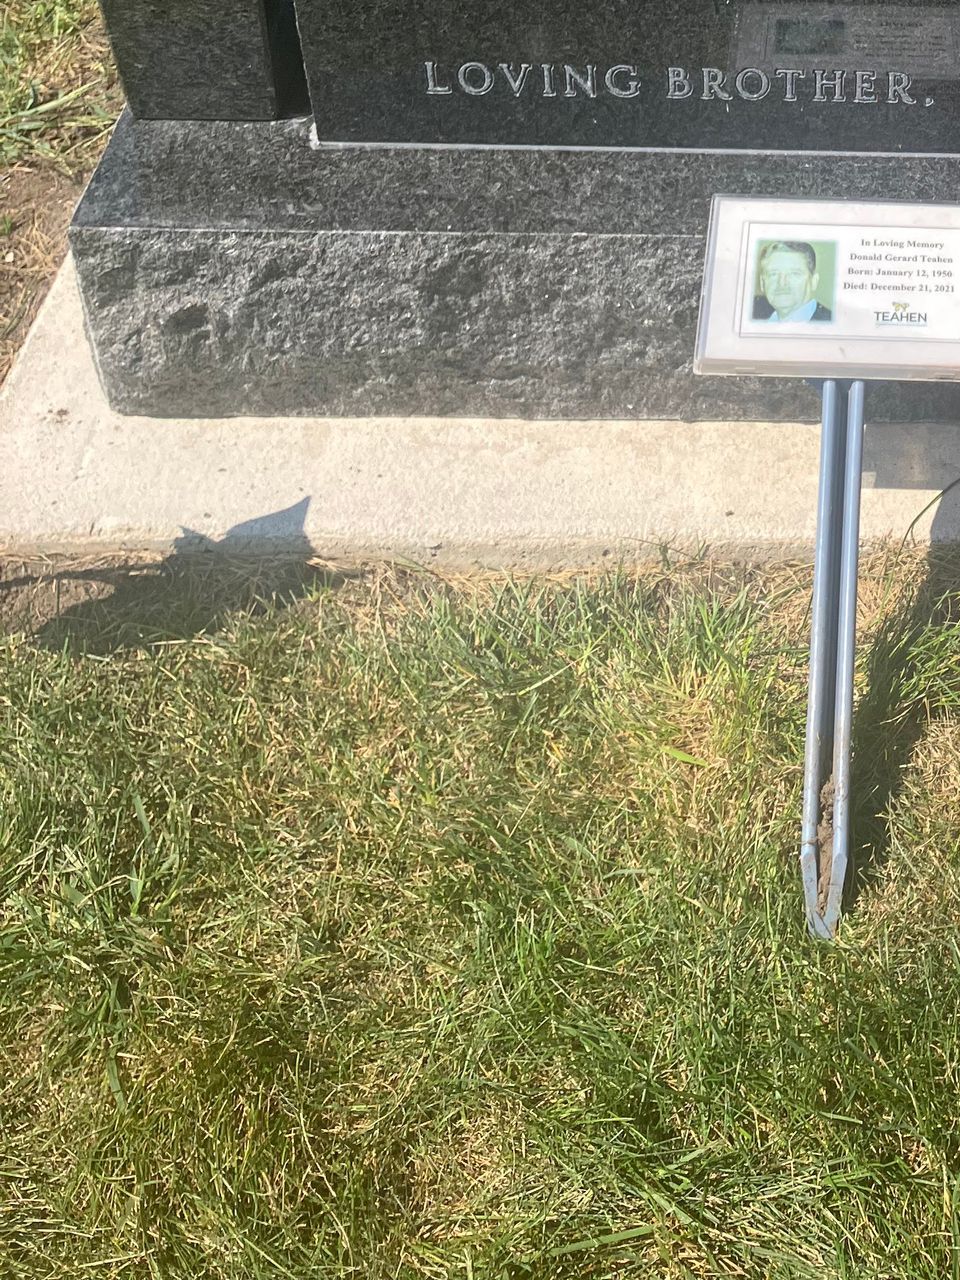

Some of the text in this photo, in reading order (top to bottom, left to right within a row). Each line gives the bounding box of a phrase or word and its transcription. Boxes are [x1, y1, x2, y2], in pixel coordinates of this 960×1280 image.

[424, 61, 642, 99] LOVING
[861, 238, 945, 250] In Loving Memory
[850, 252, 953, 264] Donald Gerard Teahen
[847, 267, 953, 278] Born: January 12, 1950
[843, 282, 955, 293] Died: December 21, 2021
[873, 311, 928, 322] TEAHEN
